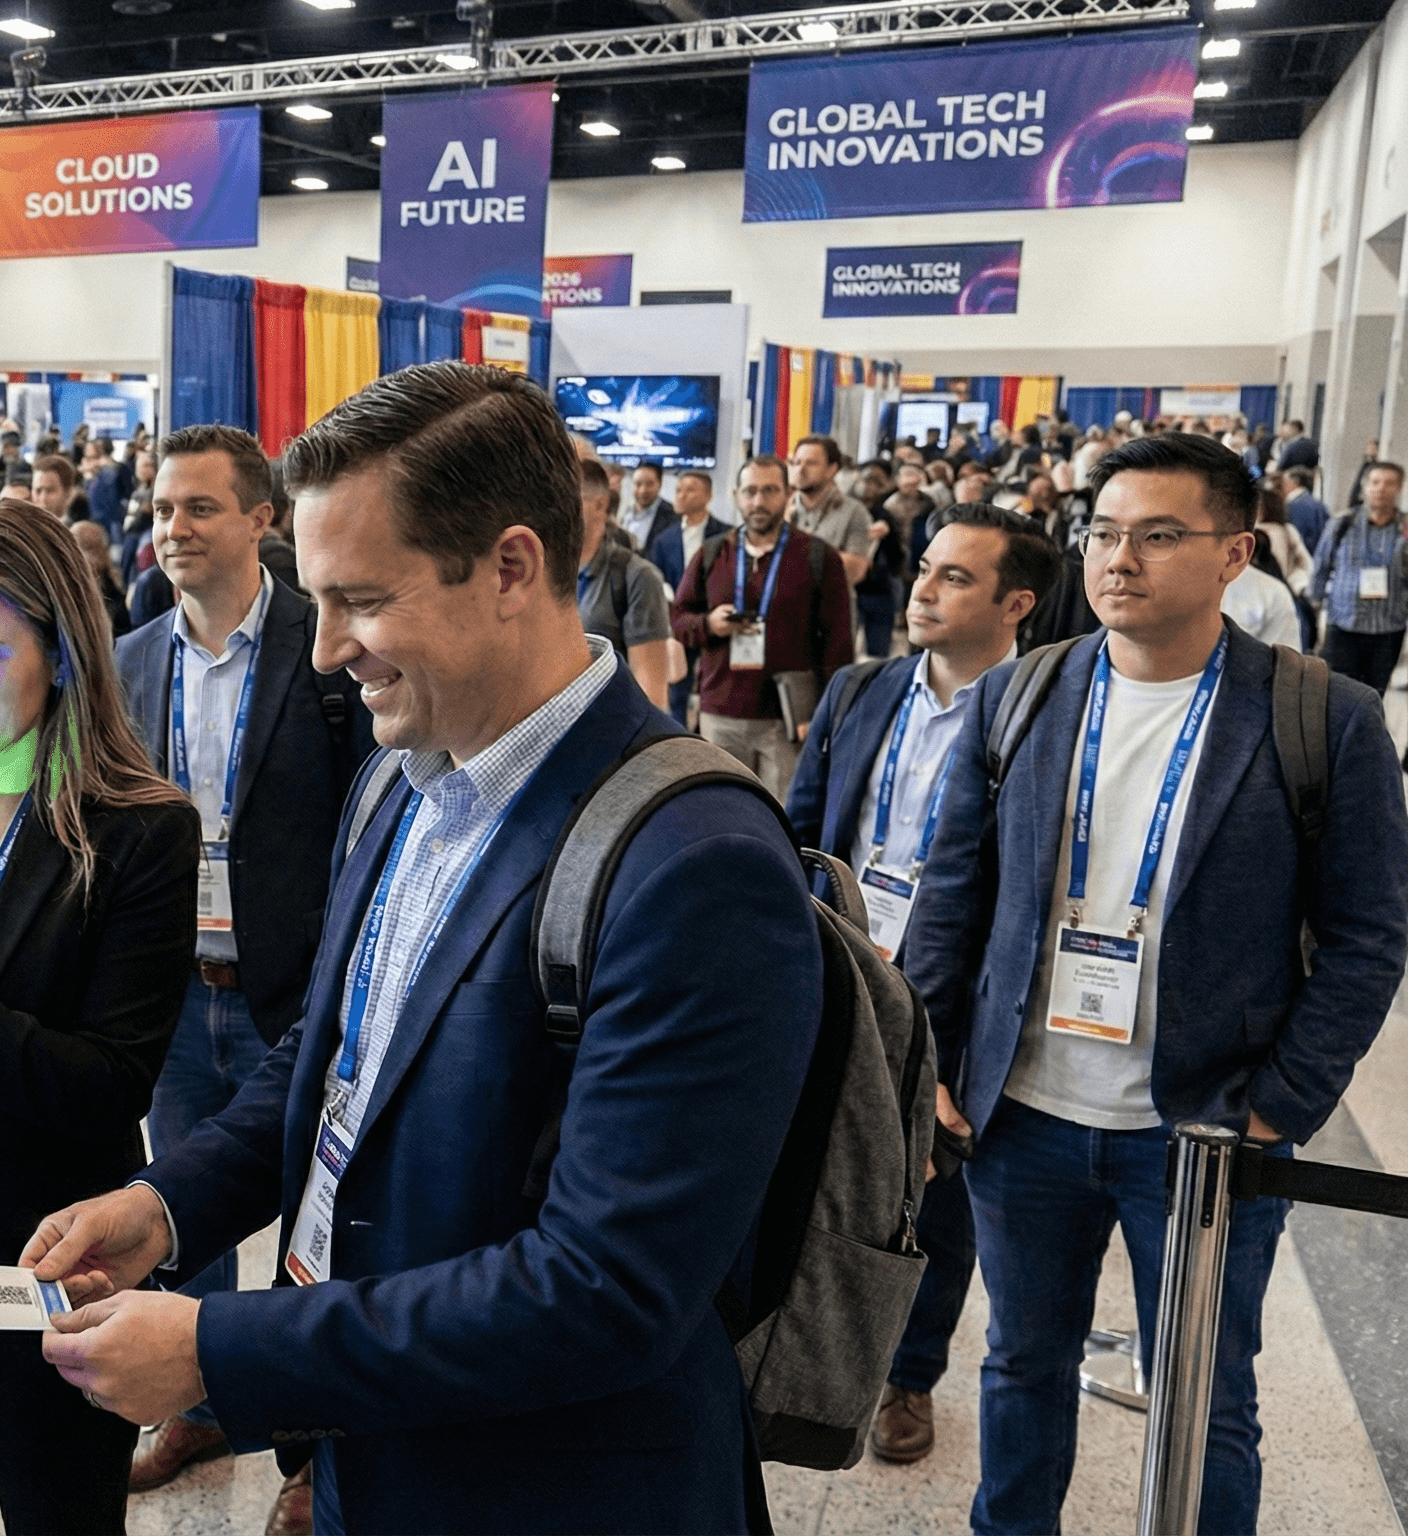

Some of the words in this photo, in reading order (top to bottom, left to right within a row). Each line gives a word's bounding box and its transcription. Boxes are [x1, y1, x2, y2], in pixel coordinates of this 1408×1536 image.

[768, 99, 928, 138] GLOBAL
[937, 89, 1047, 127] TECH
[427, 138, 497, 192] AI
[767, 125, 1046, 171] INNOVATIONS
[55, 152, 161, 185] CLOUD
[24, 182, 194, 220] SOLUTIONS
[399, 195, 527, 227] FUTURE
[832, 264, 909, 282] GLOBAL
[910, 261, 962, 279] TECH
[832, 278, 962, 298] INNOVATIONS
